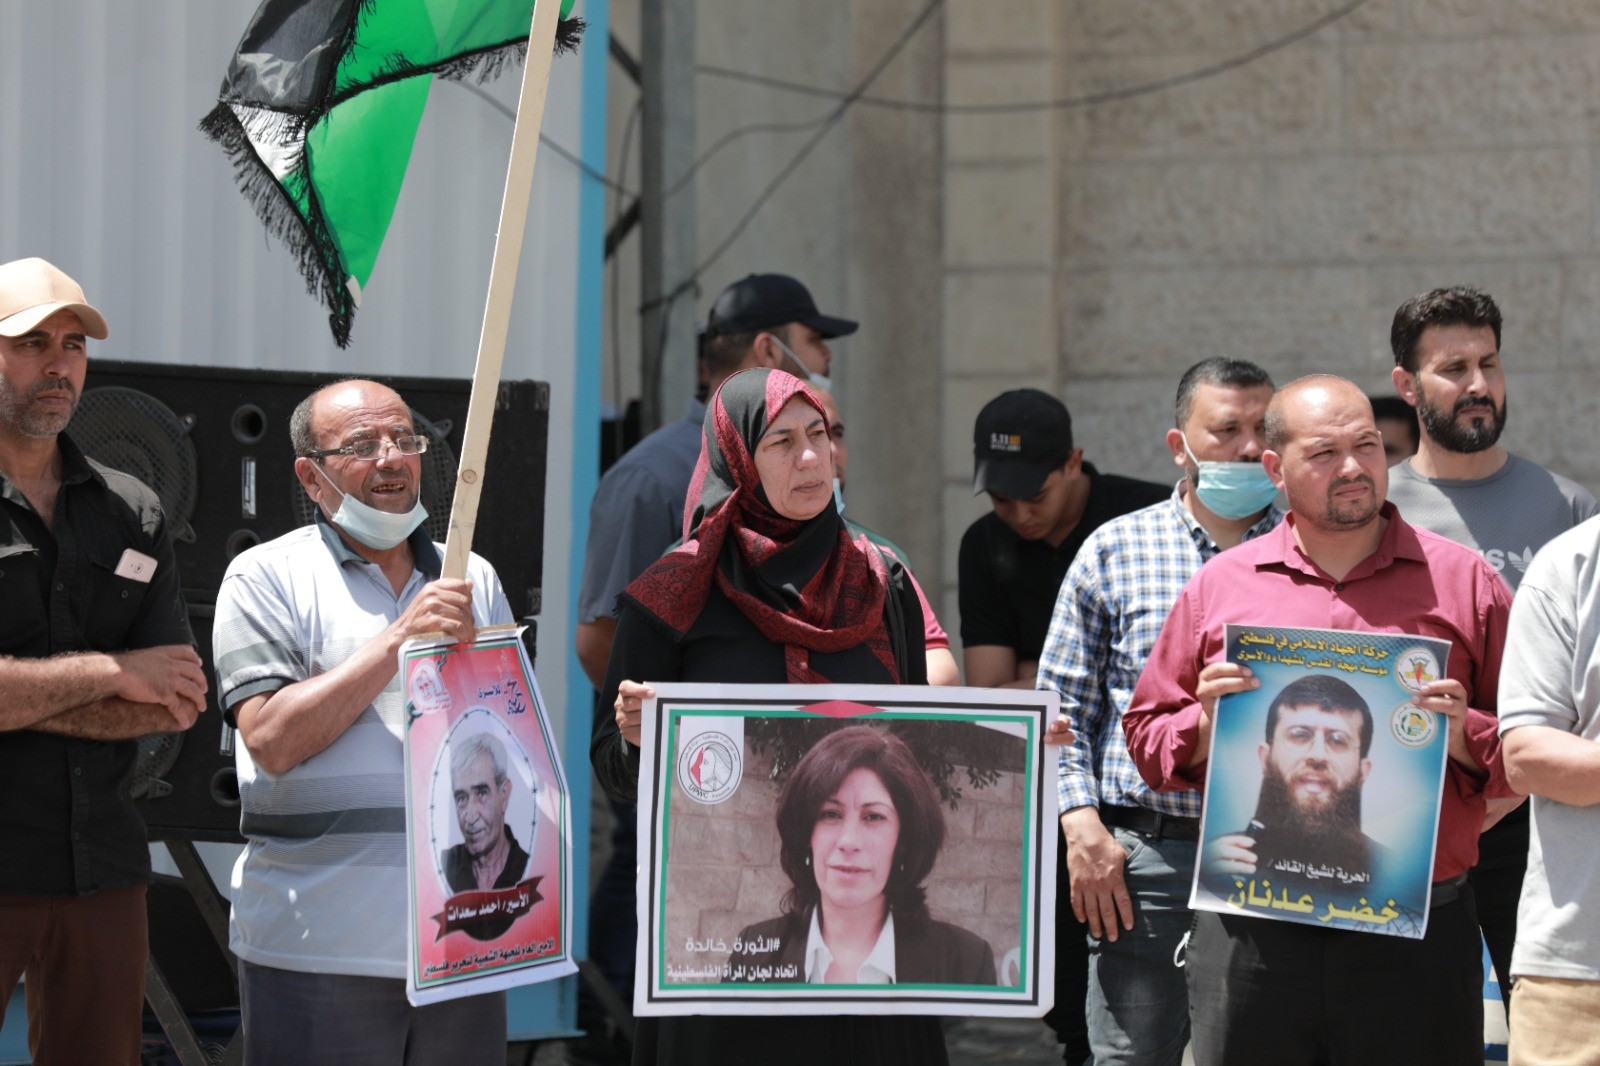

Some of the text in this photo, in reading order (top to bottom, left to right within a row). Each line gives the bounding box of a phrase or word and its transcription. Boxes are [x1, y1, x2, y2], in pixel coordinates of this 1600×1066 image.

[1239, 631, 1275, 645] فلسطين
[1276, 635, 1288, 650] في
[1330, 642, 1361, 655] الجهاد
[1363, 644, 1389, 660] حركة
[1306, 656, 1335, 668] القدس
[1306, 862, 1336, 880] للشيخ
[1337, 867, 1370, 884] الحرية
[1226, 878, 1400, 925] خضر عدنان
[447, 903, 477, 922] سعدات
[474, 949, 498, 966] الشعبية
[500, 944, 520, 960] للجبهة
[424, 960, 450, 977] فلسطين
[667, 963, 798, 982] اتحاد لجان المرأة الفلسطينية
